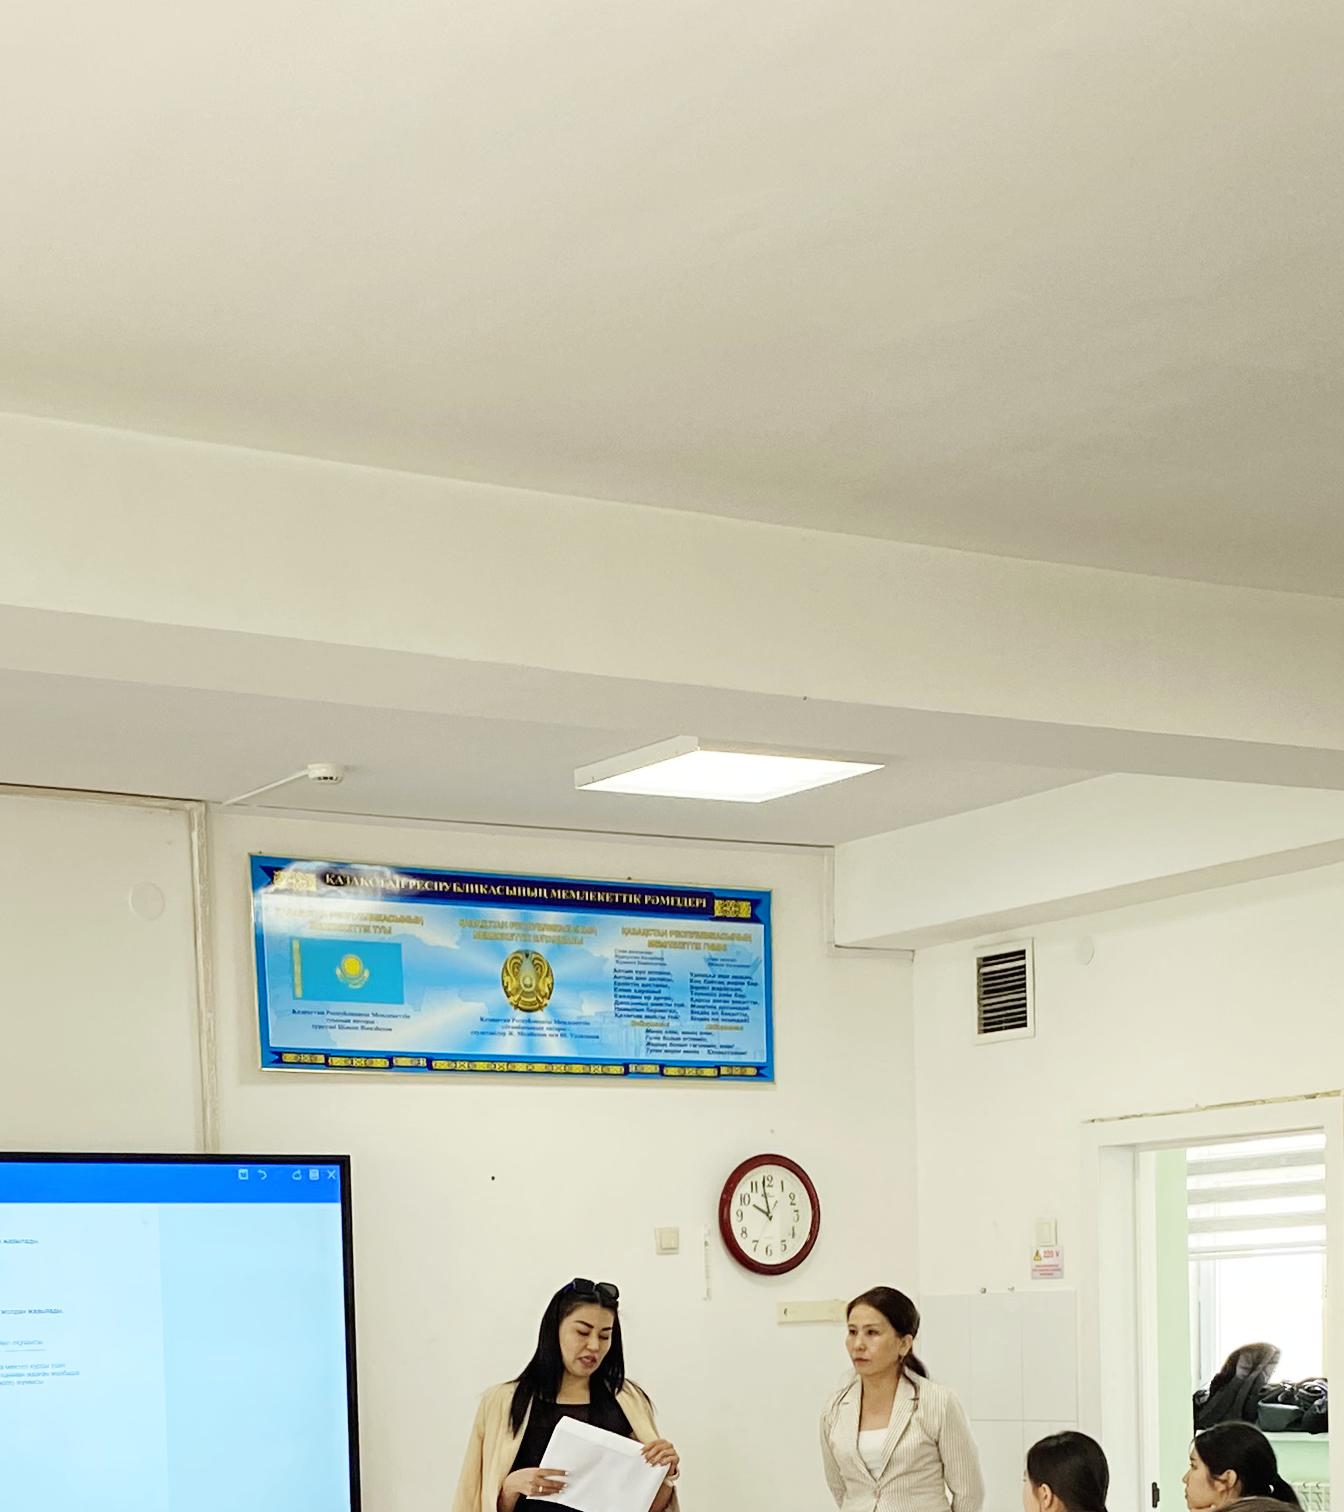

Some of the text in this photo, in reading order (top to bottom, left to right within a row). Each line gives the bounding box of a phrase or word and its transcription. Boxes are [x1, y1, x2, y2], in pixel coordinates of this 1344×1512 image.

[750, 1180, 758, 1193] 11
[780, 1180, 784, 1193] 1
[739, 1192, 751, 1207] 10
[788, 1192, 796, 1206] 2
[736, 1209, 744, 1223] 9
[740, 1226, 748, 1239] 8
[751, 1239, 759, 1252] 7
[765, 1244, 773, 1257] 6
[780, 1240, 788, 1252] 5
